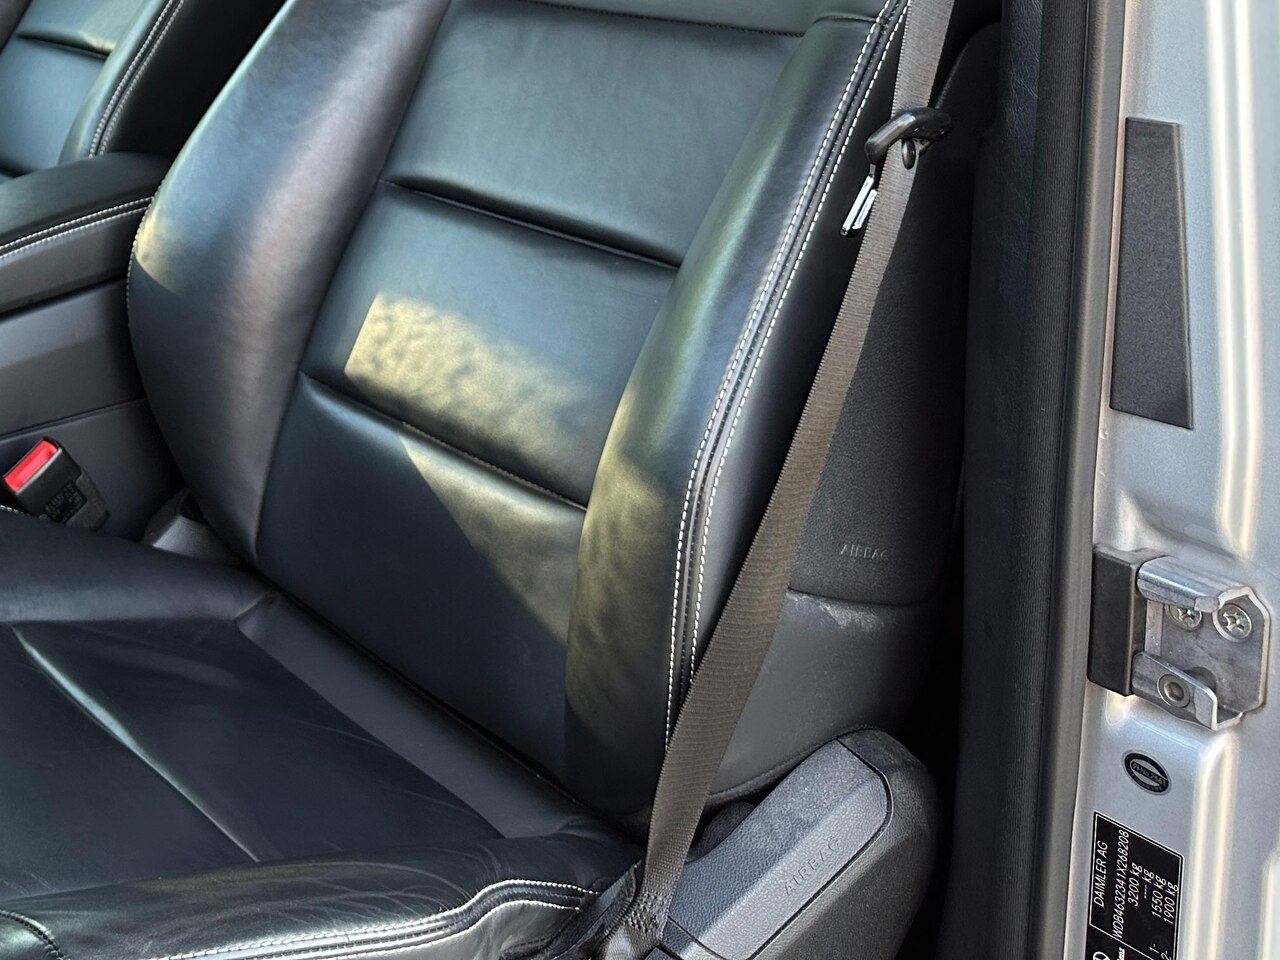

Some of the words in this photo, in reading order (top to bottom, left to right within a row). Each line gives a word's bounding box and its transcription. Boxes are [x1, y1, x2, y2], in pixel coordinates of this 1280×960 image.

[839, 544, 890, 561] AIRBAG
[1096, 840, 1108, 859] AG
[784, 836, 840, 898] AIRBAG
[1129, 861, 1143, 877] kg
[1141, 868, 1155, 883] kg
[1093, 857, 1107, 908] DAIMLER
[1112, 829, 1129, 939] WDB4632341X268208
[1127, 877, 1139, 907] 3200
[1153, 874, 1167, 890] kg
[1165, 881, 1179, 897] kg
[1151, 890, 1163, 918] 1550
[1163, 896, 1176, 925] 1900
